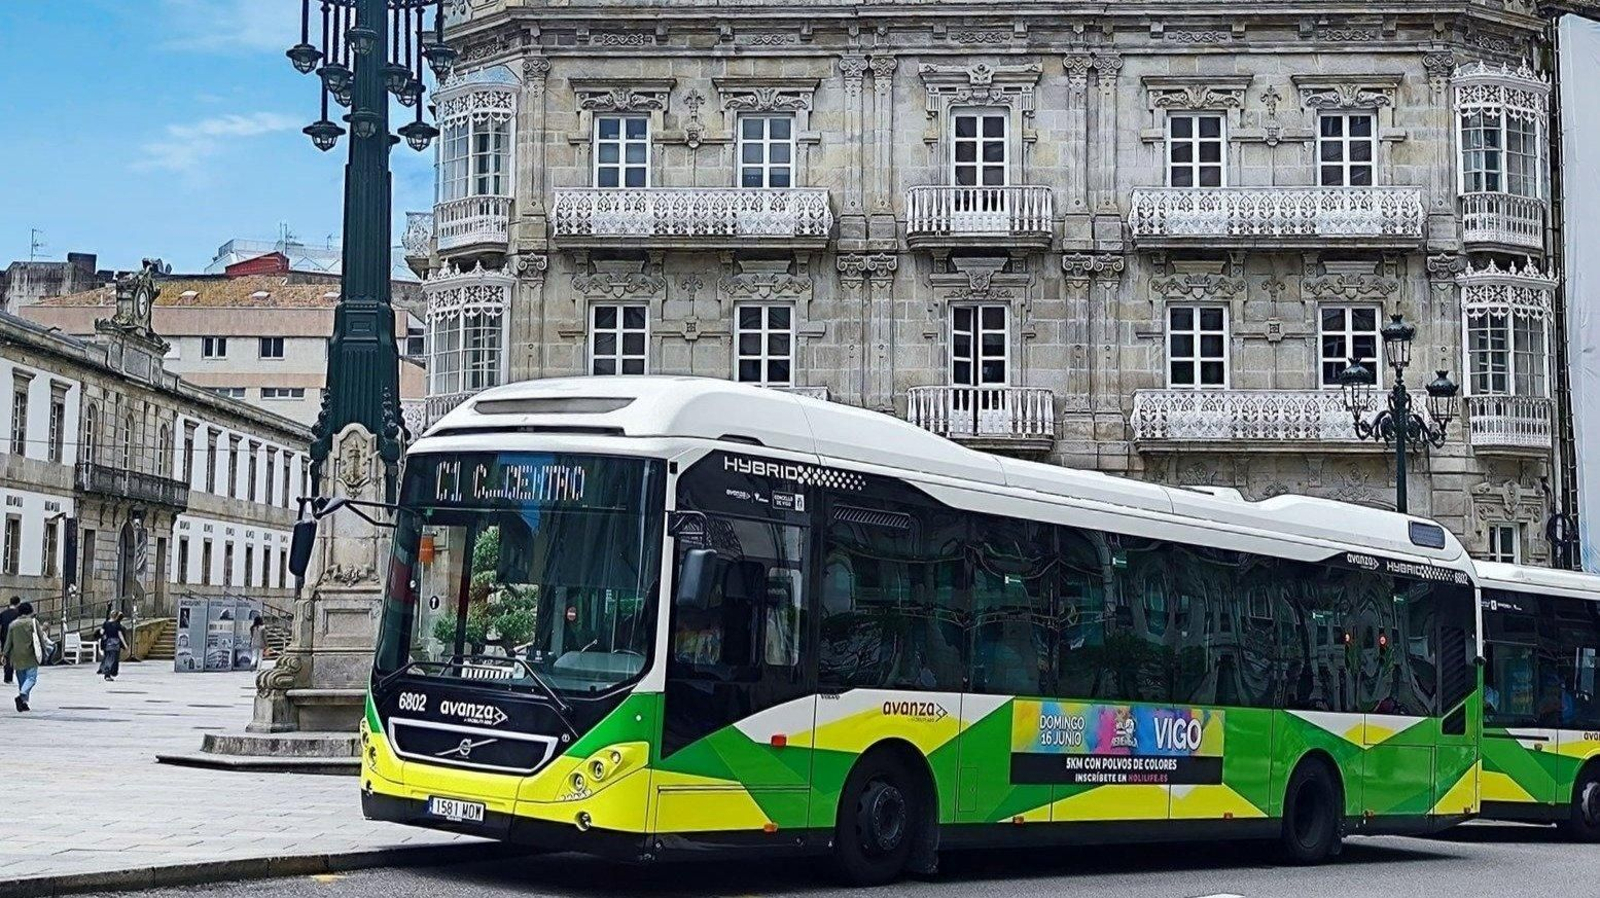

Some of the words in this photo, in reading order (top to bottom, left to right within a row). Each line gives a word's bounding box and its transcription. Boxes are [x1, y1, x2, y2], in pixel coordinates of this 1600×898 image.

[724, 456, 798, 481] HYBRID
[1347, 553, 1373, 566] avanza
[1386, 561, 1421, 576] HYBRID
[1454, 572, 1469, 586] 6802
[398, 692, 427, 713] 6802
[440, 700, 494, 720] avanza
[883, 700, 935, 716] avanza
[1039, 715, 1085, 731] DOMINGO
[1041, 733, 1051, 746] 16
[1053, 733, 1082, 747] JUNIO
[1154, 717, 1203, 751] VIGO
[1066, 757, 1083, 770] 5KM
[1084, 757, 1101, 770] CON
[1102, 757, 1132, 770] POLVOS
[1133, 758, 1143, 770] DE
[1144, 758, 1178, 770] COLORES
[1118, 773, 1127, 782] EN
[437, 800, 458, 816] 1581
